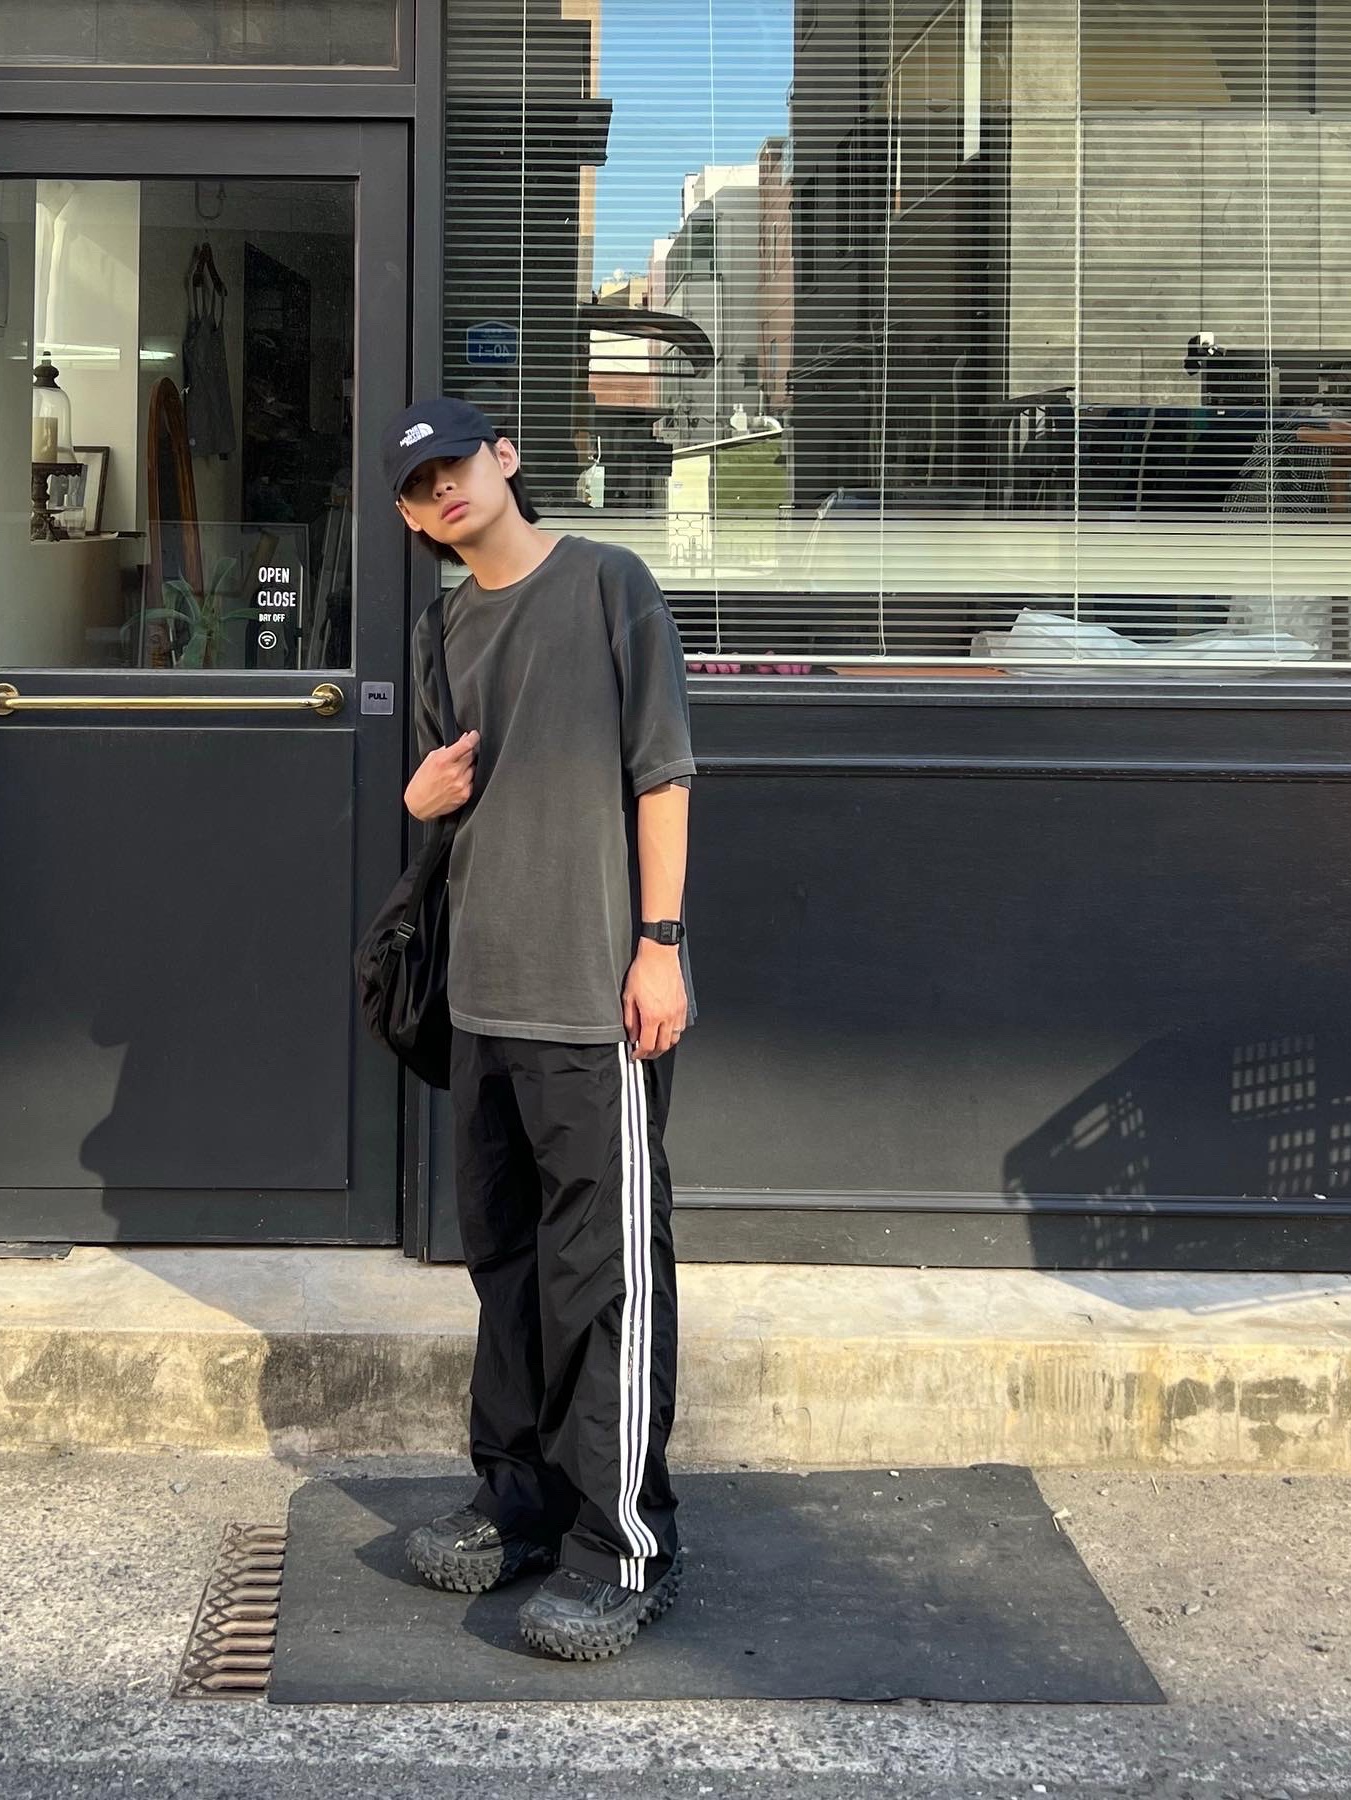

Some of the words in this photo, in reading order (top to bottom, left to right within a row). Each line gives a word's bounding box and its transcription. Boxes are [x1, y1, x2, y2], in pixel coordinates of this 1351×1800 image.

[258, 566, 290, 583] OPEN
[257, 591, 297, 607] CLOSE
[258, 613, 271, 622] DAY
[272, 613, 286, 622] OFF
[368, 692, 388, 700] PULL
